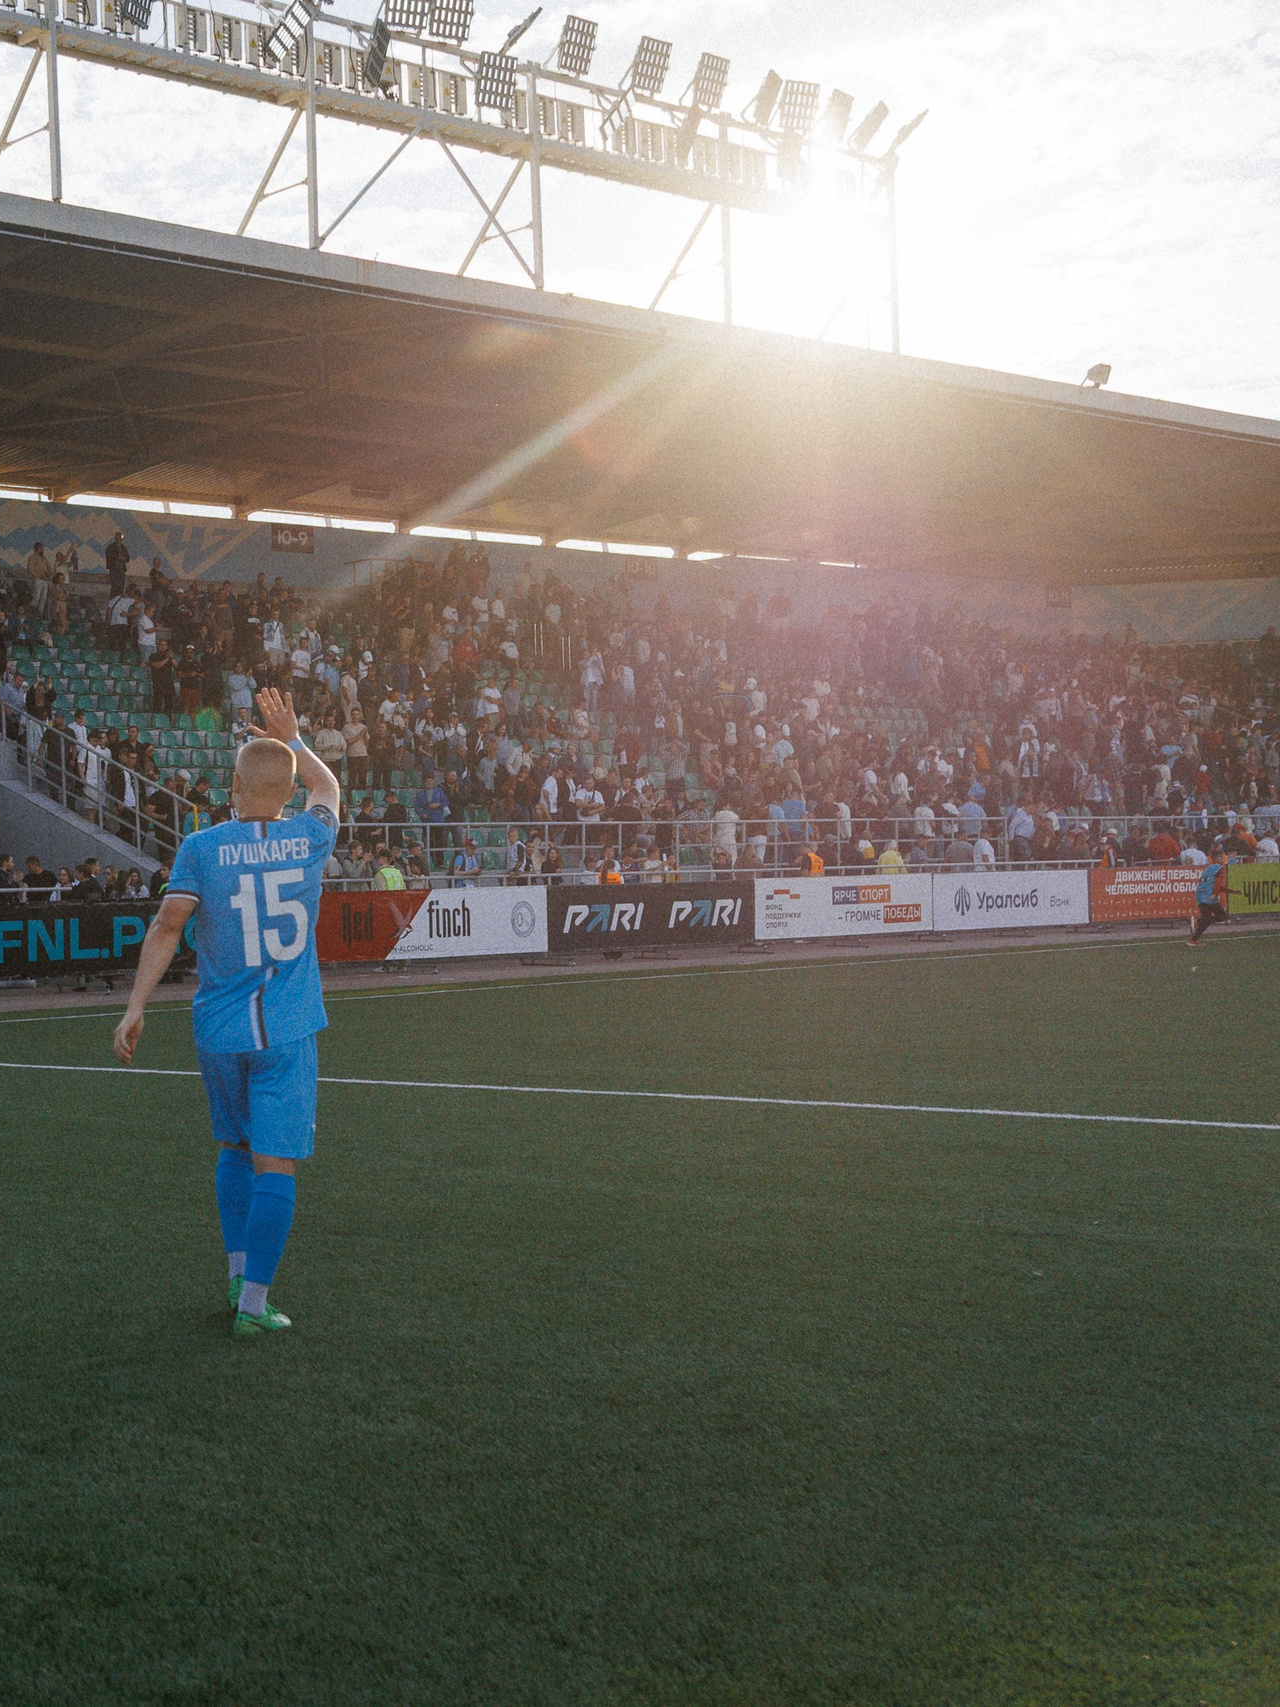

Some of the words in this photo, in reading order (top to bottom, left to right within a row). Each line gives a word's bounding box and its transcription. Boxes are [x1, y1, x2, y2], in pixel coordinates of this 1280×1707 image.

[277, 530, 308, 546] Ю-9
[219, 837, 311, 866] ПУШКАРЕВ
[1105, 880, 1172, 895] ЧЕЛЯБИНСКОЙ
[1115, 869, 1166, 883] ДВИЖЕНИЕ
[1167, 869, 1203, 881] ПЕРВЫХ
[833, 890, 857, 902] ЯРЧЕ
[860, 888, 889, 901] СПОРТ
[976, 888, 1039, 913] Уралсиб
[1049, 896, 1071, 907] Банк
[1243, 880, 1280, 905] ЧИПС
[230, 868, 308, 967] 15
[427, 898, 471, 938] finch
[563, 902, 645, 934] PARI
[668, 898, 742, 928] PARI
[845, 910, 881, 922] ГРОМЧЕ
[884, 906, 920, 921] ПОБЕДЫ
